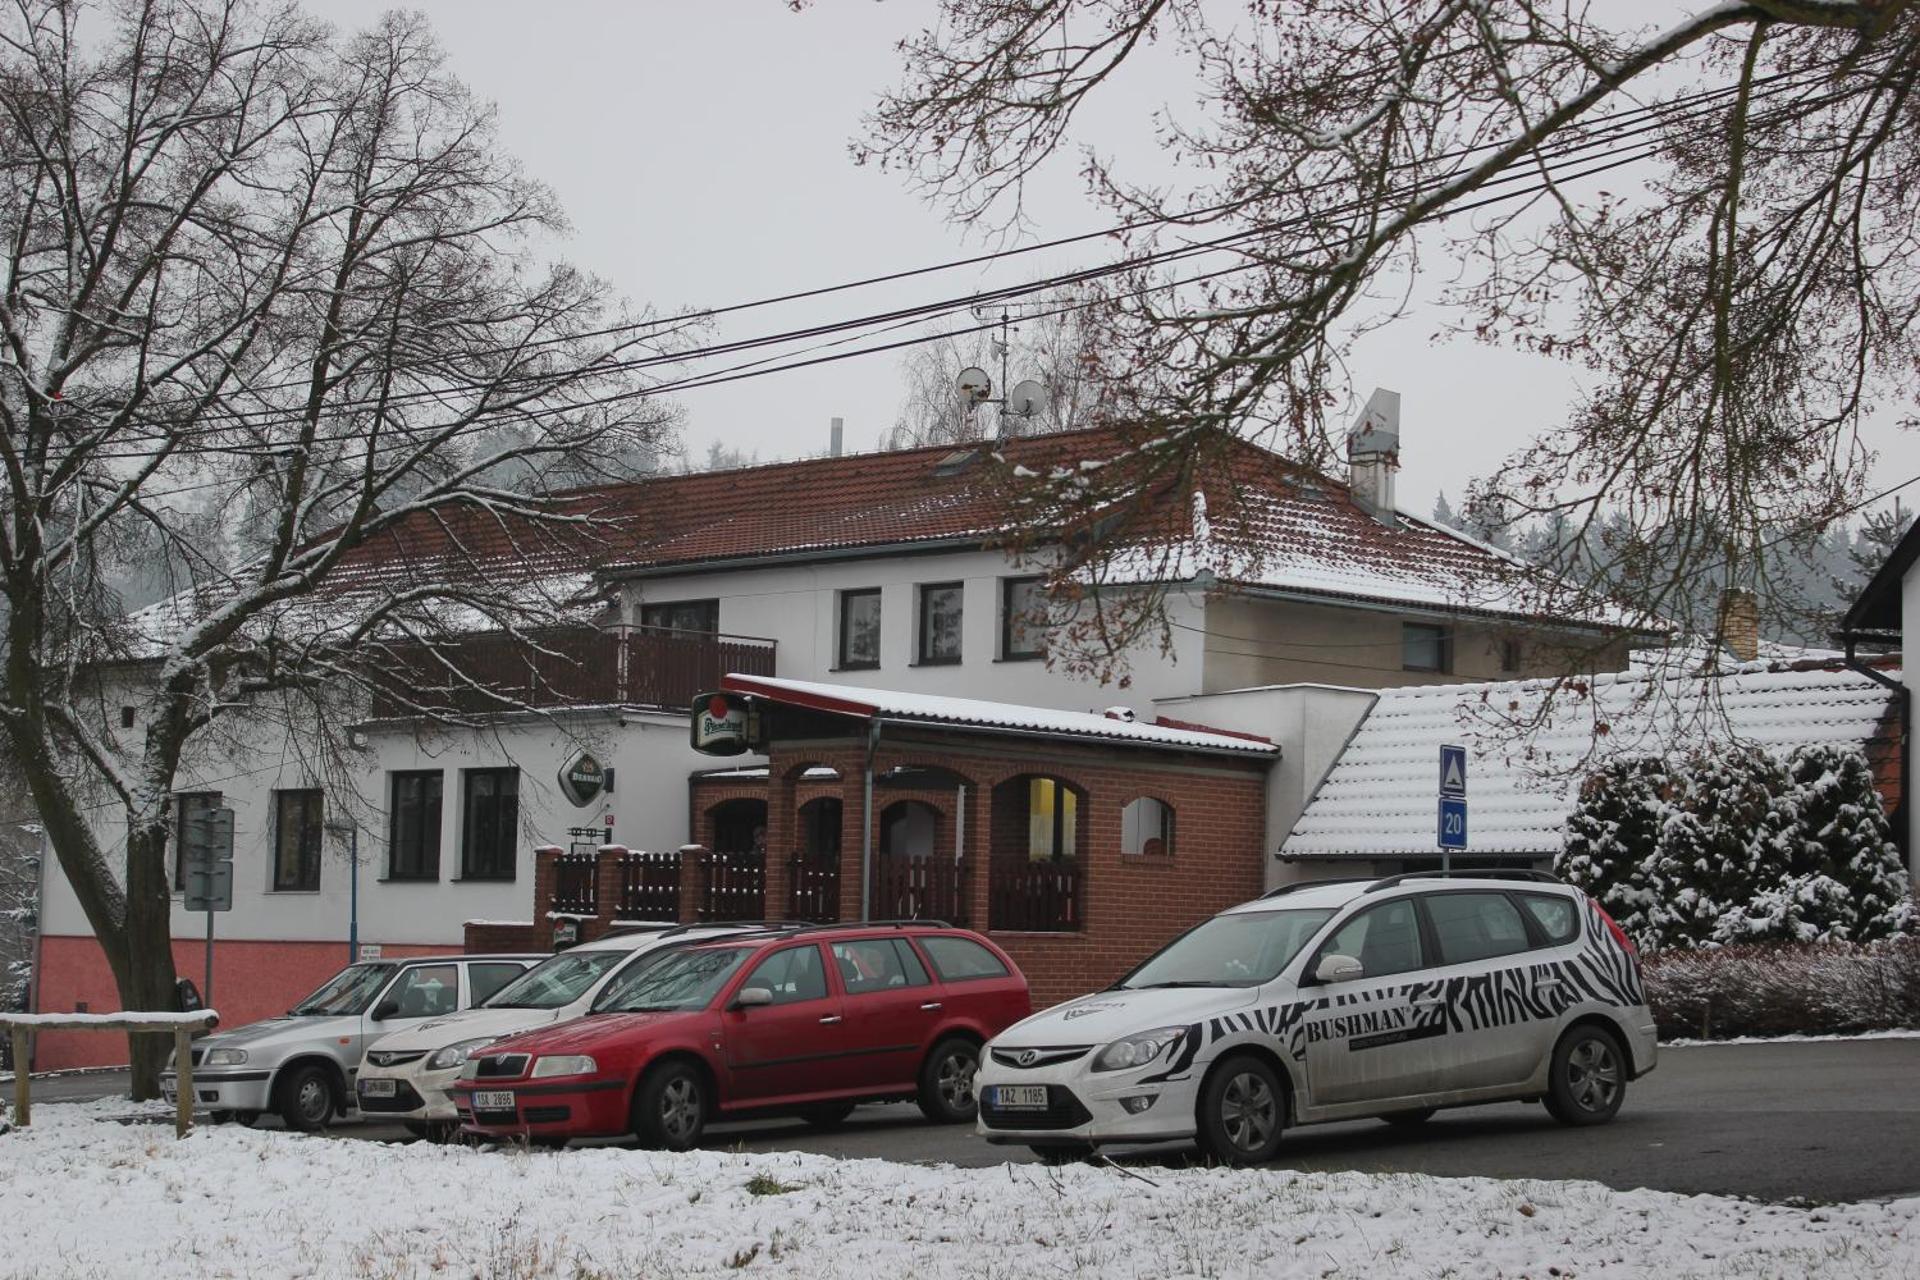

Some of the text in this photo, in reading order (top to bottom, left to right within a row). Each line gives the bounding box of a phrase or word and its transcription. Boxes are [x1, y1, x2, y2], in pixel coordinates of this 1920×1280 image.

[1445, 812, 1462, 835] 20
[1306, 1006, 1406, 1043] BUSHMAN
[1000, 1087, 1044, 1104] 1AZ 1185
